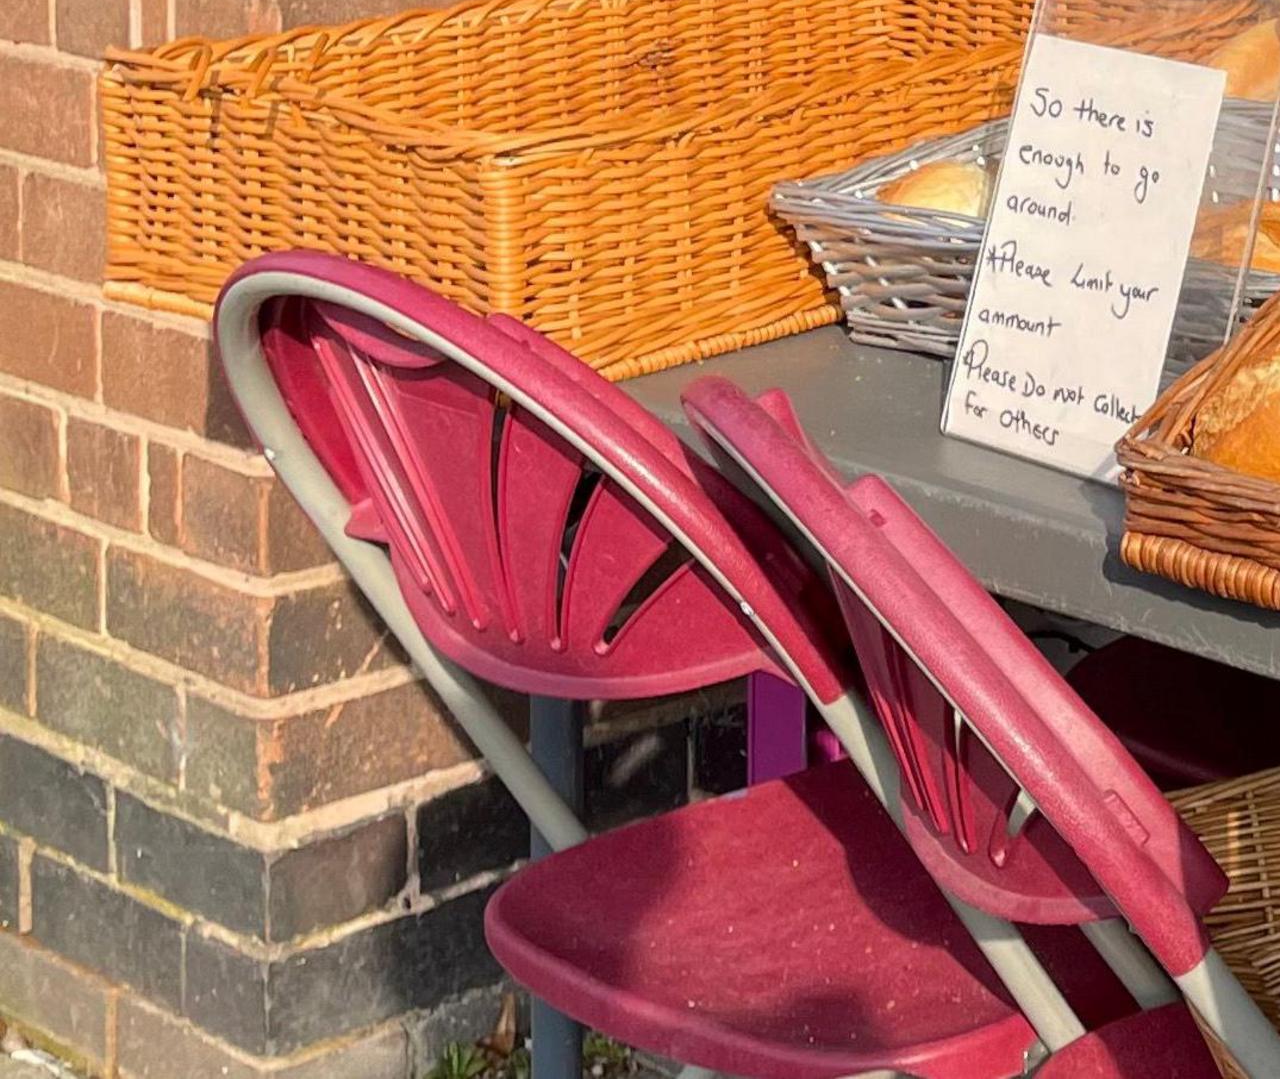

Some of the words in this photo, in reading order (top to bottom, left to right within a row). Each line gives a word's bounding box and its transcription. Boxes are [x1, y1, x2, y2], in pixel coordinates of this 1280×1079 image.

[1030, 88, 1063, 118] So
[1073, 97, 1126, 133] there
[1135, 109, 1154, 138] is
[1019, 144, 1084, 189] enough
[1104, 150, 1121, 176] to
[1134, 167, 1159, 204] go
[1111, 284, 1159, 319] your
[978, 308, 1063, 337] ammount
[1023, 372, 1046, 398] Do
